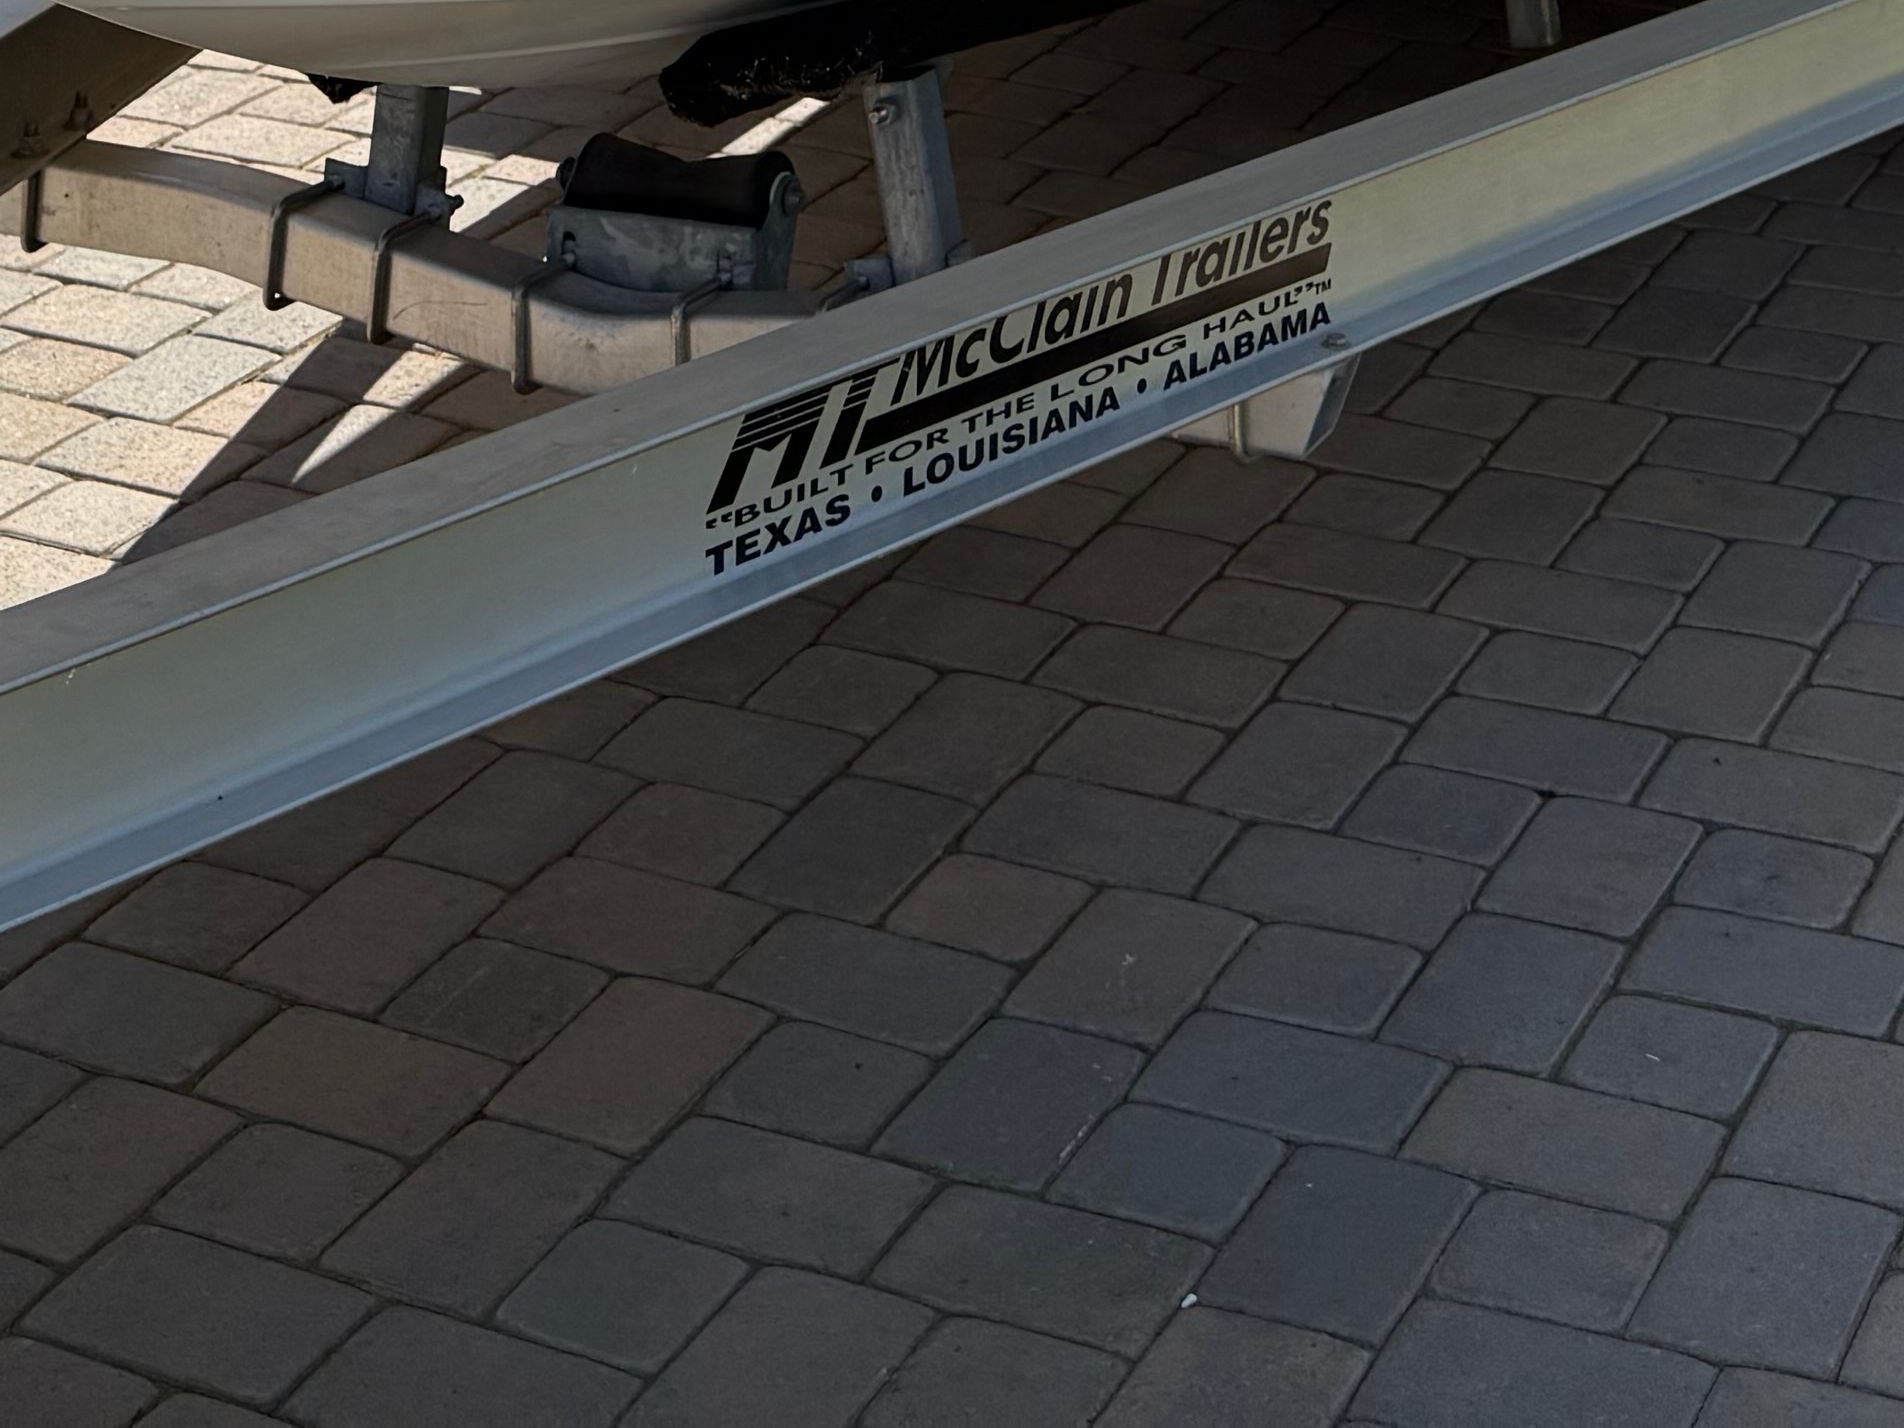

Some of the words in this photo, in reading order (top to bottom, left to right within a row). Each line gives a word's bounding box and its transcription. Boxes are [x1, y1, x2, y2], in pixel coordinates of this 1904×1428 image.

[865, 428, 949, 475] FOR
[961, 393, 1035, 434] THE
[1051, 334, 1188, 402] LONG
[890, 273, 1134, 406] McClain
[705, 493, 851, 576] TEXAS
[903, 386, 1121, 498] LOUISIANA
[1163, 301, 1331, 392] ALABAMA
